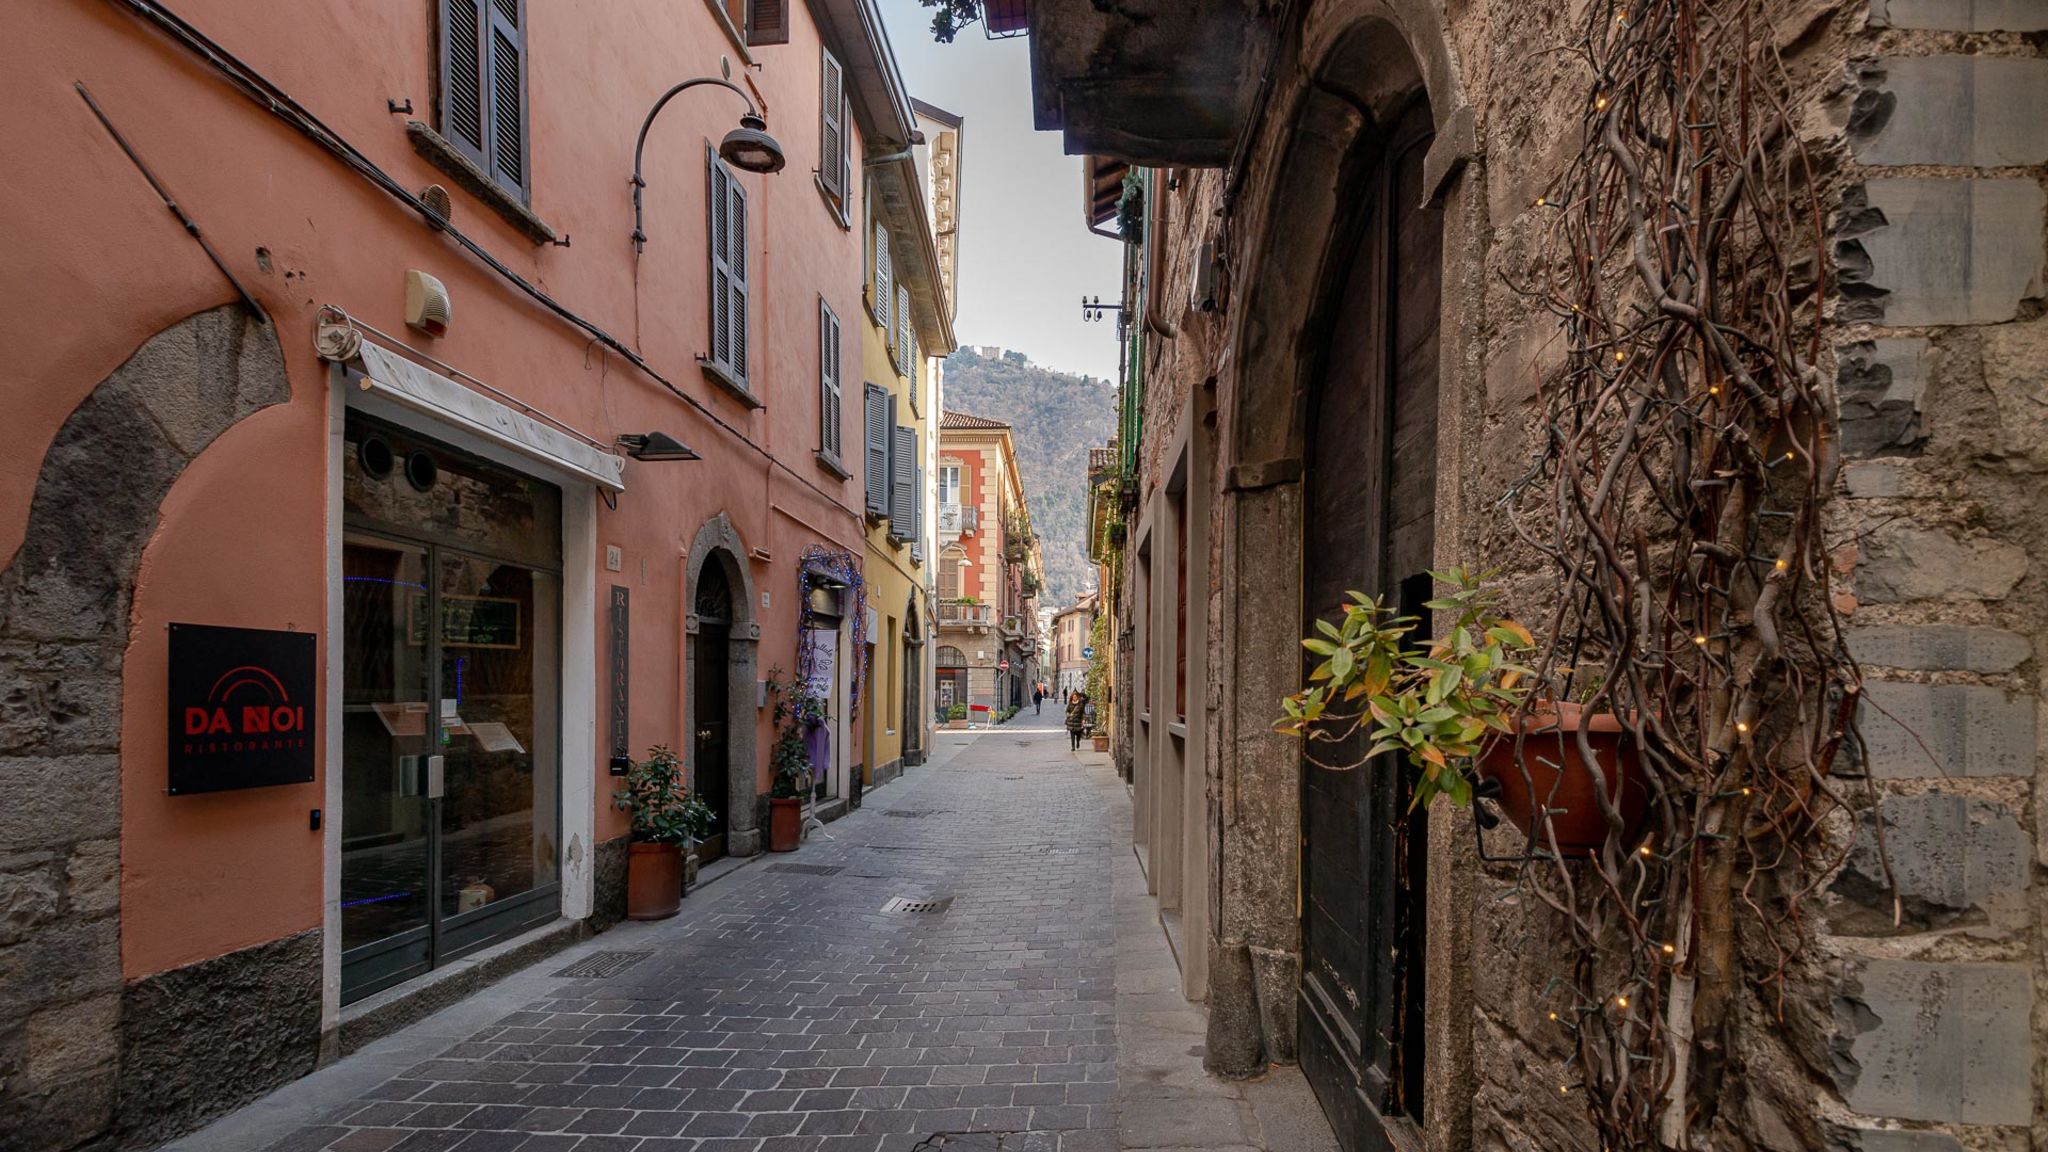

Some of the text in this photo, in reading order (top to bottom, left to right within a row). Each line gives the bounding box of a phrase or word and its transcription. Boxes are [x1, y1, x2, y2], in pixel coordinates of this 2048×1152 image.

[609, 551, 619, 567] 24
[615, 591, 625, 750] RISTORANTE
[185, 706, 304, 735] DA NOI
[185, 739, 305, 754] RISTORANTE
